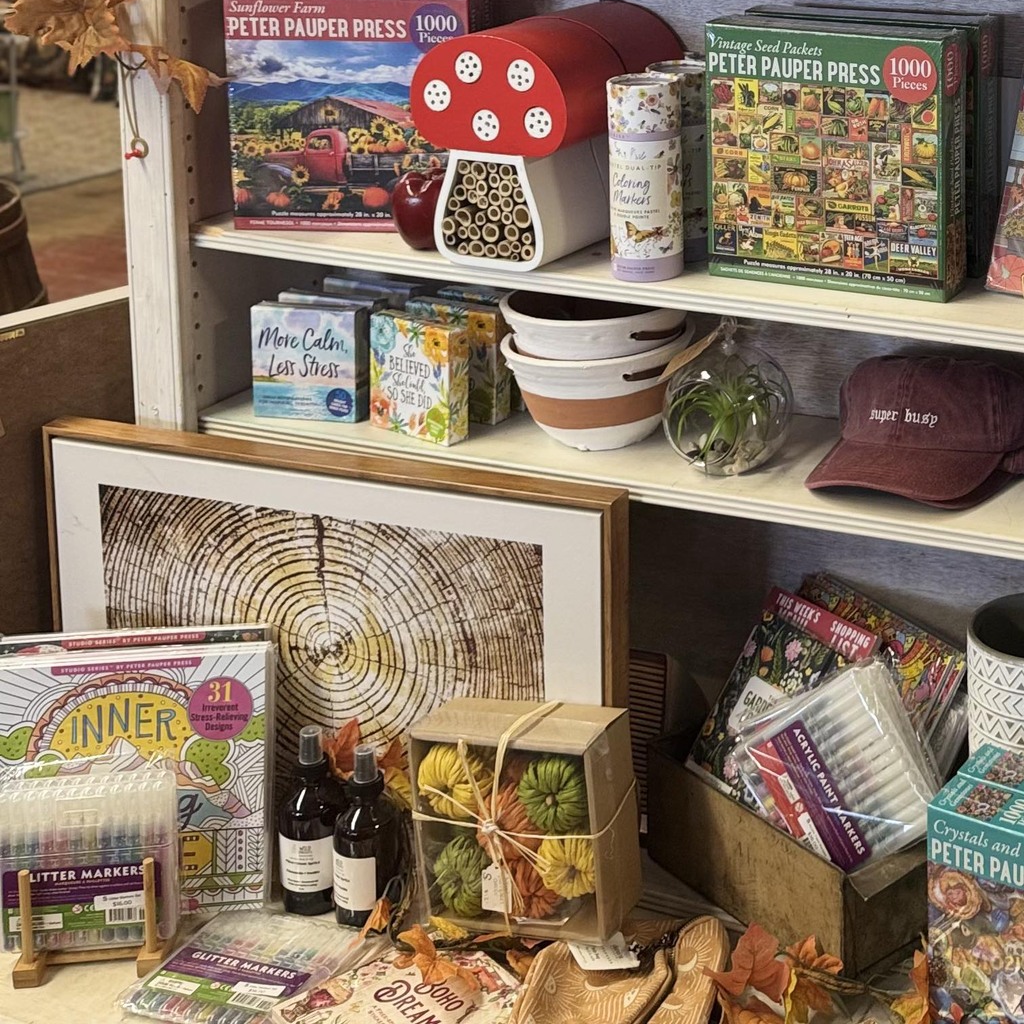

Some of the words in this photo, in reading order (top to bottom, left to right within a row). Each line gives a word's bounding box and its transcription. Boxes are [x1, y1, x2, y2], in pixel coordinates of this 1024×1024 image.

[229, 0, 290, 16] Sunflower
[293, 2, 326, 14] Farm
[228, 16, 280, 36] PETER
[285, 18, 348, 38] PAUPER
[354, 19, 406, 38] PRESS
[416, 14, 458, 32] 1000
[708, 37, 752, 54] Vintage
[754, 40, 780, 54] Seed
[782, 42, 822, 57] Packets
[708, 52, 757, 76] PETER
[762, 56, 823, 81] PAUPER
[828, 62, 880, 86] PRESS
[888, 57, 932, 78] 1000
[892, 76, 928, 92] Pieces
[612, 172, 650, 196] Coloring
[613, 190, 651, 206] Markers
[890, 242, 910, 254] DEER
[910, 245, 937, 256] VALLEY
[258, 326, 300, 350] More
[302, 327, 348, 354] Calm,
[403, 343, 416, 358] She
[268, 354, 295, 377] Less
[299, 354, 340, 378] Stress
[389, 355, 430, 379] BELIEVED
[387, 386, 398, 401] SO
[400, 390, 416, 406] SHE
[418, 394, 432, 410] DID
[869, 407, 899, 424] super
[904, 408, 939, 428] busy
[776, 593, 794, 609] THIS
[794, 601, 822, 624] WEEK'S
[68, 640, 93, 648] STUDIO
[156, 634, 178, 642] PAUPER
[830, 620, 871, 649] SHOPPING
[208, 681, 232, 703] 31
[190, 712, 248, 723] Stress-Relieving
[202, 703, 239, 712] Irreverent
[71, 698, 176, 746] INNER
[204, 722, 233, 732] Designs
[793, 728, 820, 772] ACRYLIC
[817, 772, 838, 804] PAINT
[834, 805, 866, 855] MARKERS
[933, 819, 988, 848] Crystals
[991, 840, 1020, 858] and
[932, 837, 984, 875] PETER
[30, 870, 76, 883] LITTER
[81, 865, 144, 880] MARKERS
[192, 951, 240, 967] GLITTER
[240, 962, 297, 980] MARKERS
